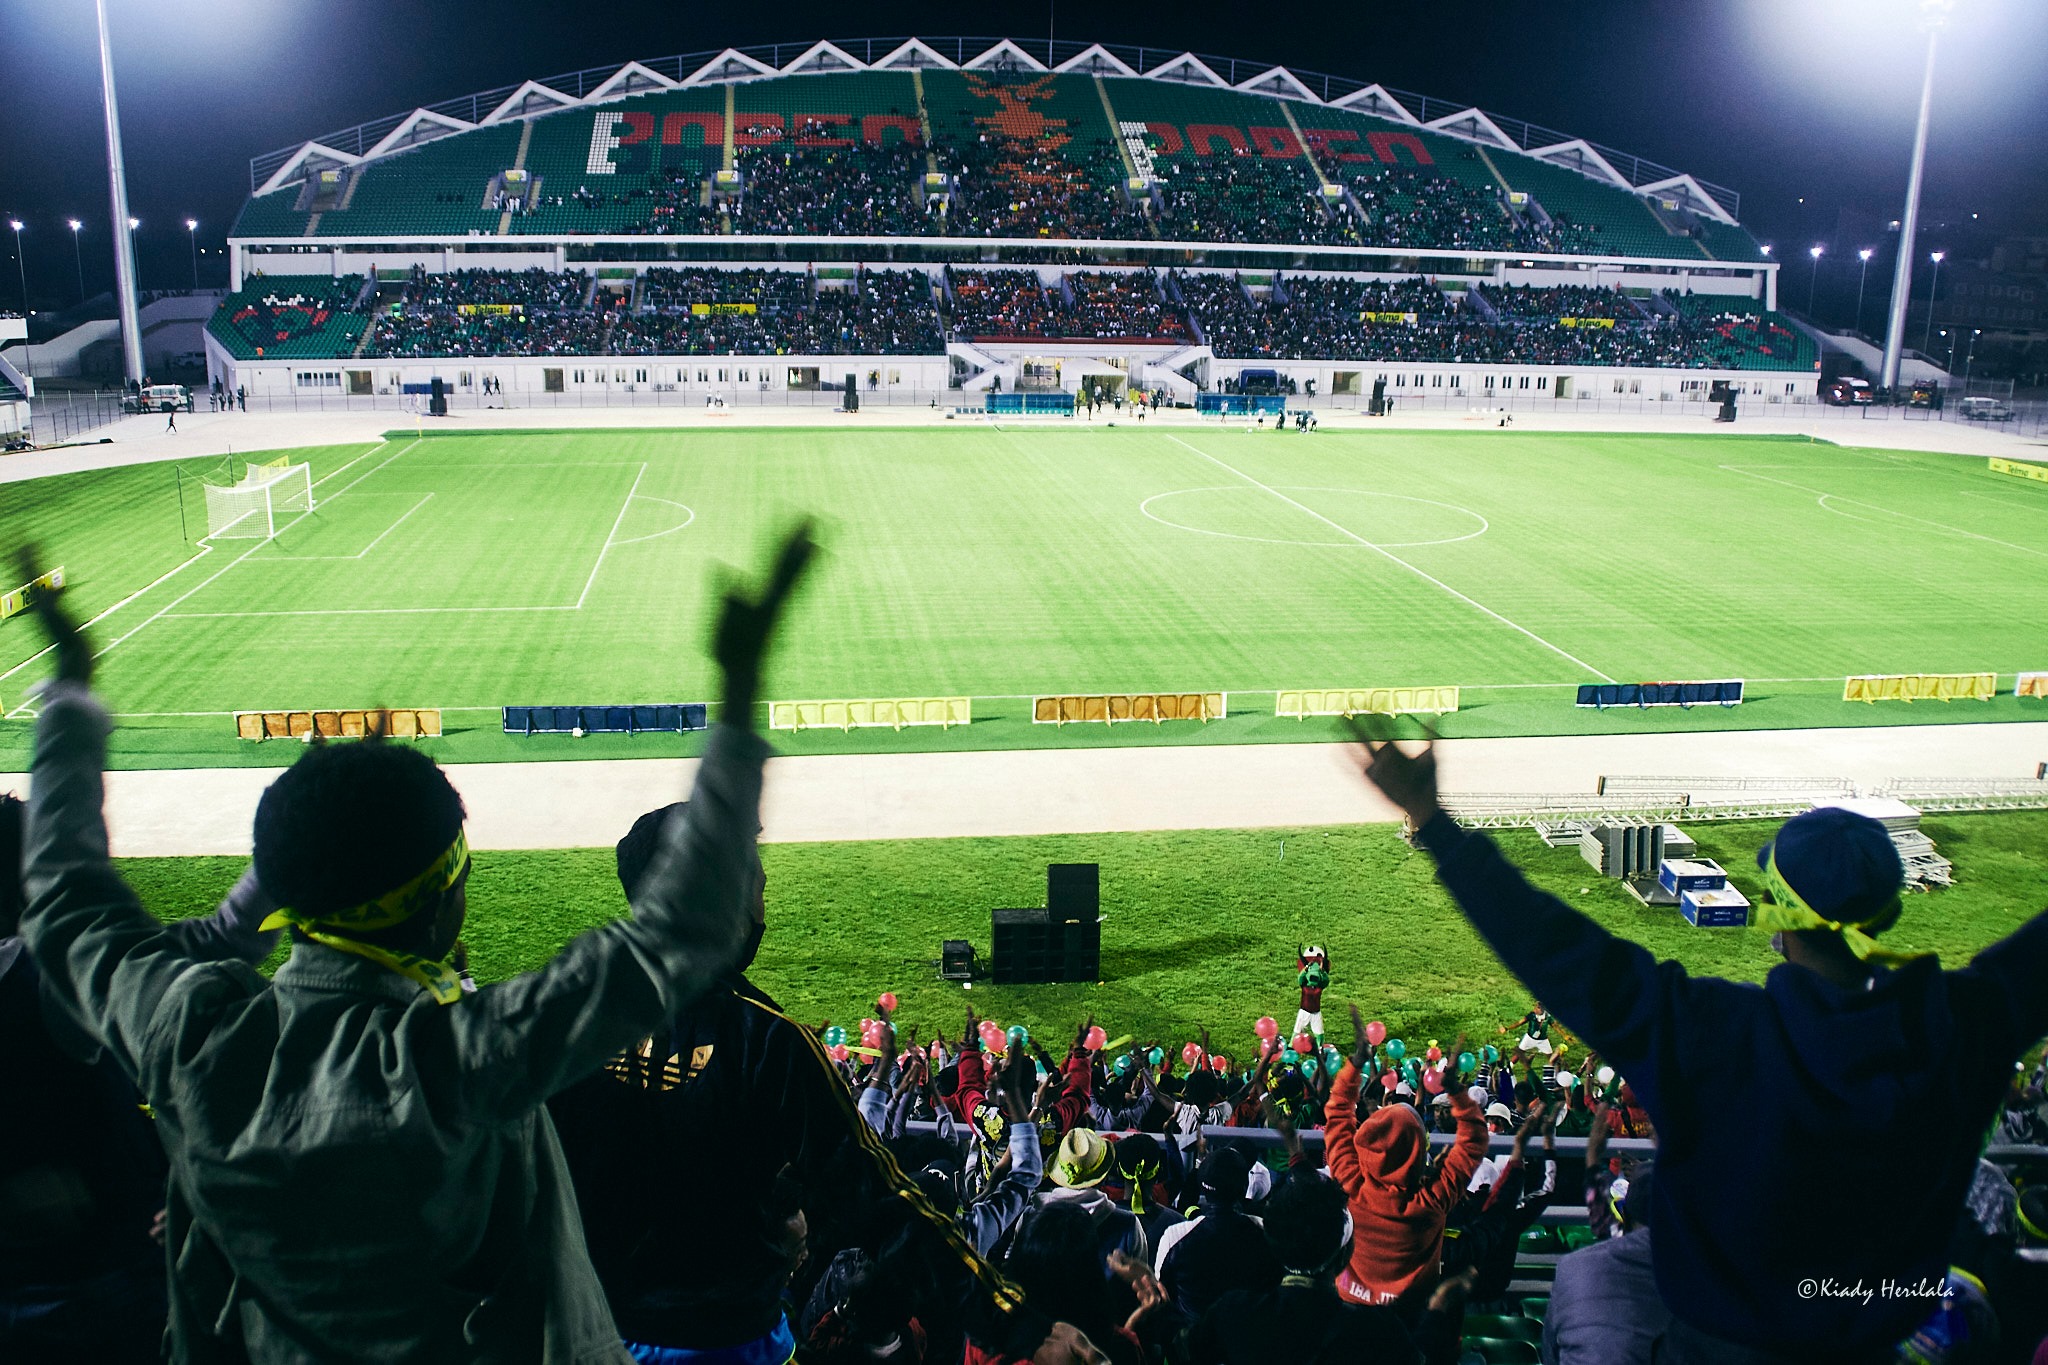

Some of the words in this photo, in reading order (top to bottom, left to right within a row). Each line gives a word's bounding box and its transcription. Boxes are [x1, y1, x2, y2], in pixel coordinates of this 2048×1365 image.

[474, 304, 503, 315] Telma
[708, 303, 740, 313] Telma
[2007, 464, 2029, 477] Telma
